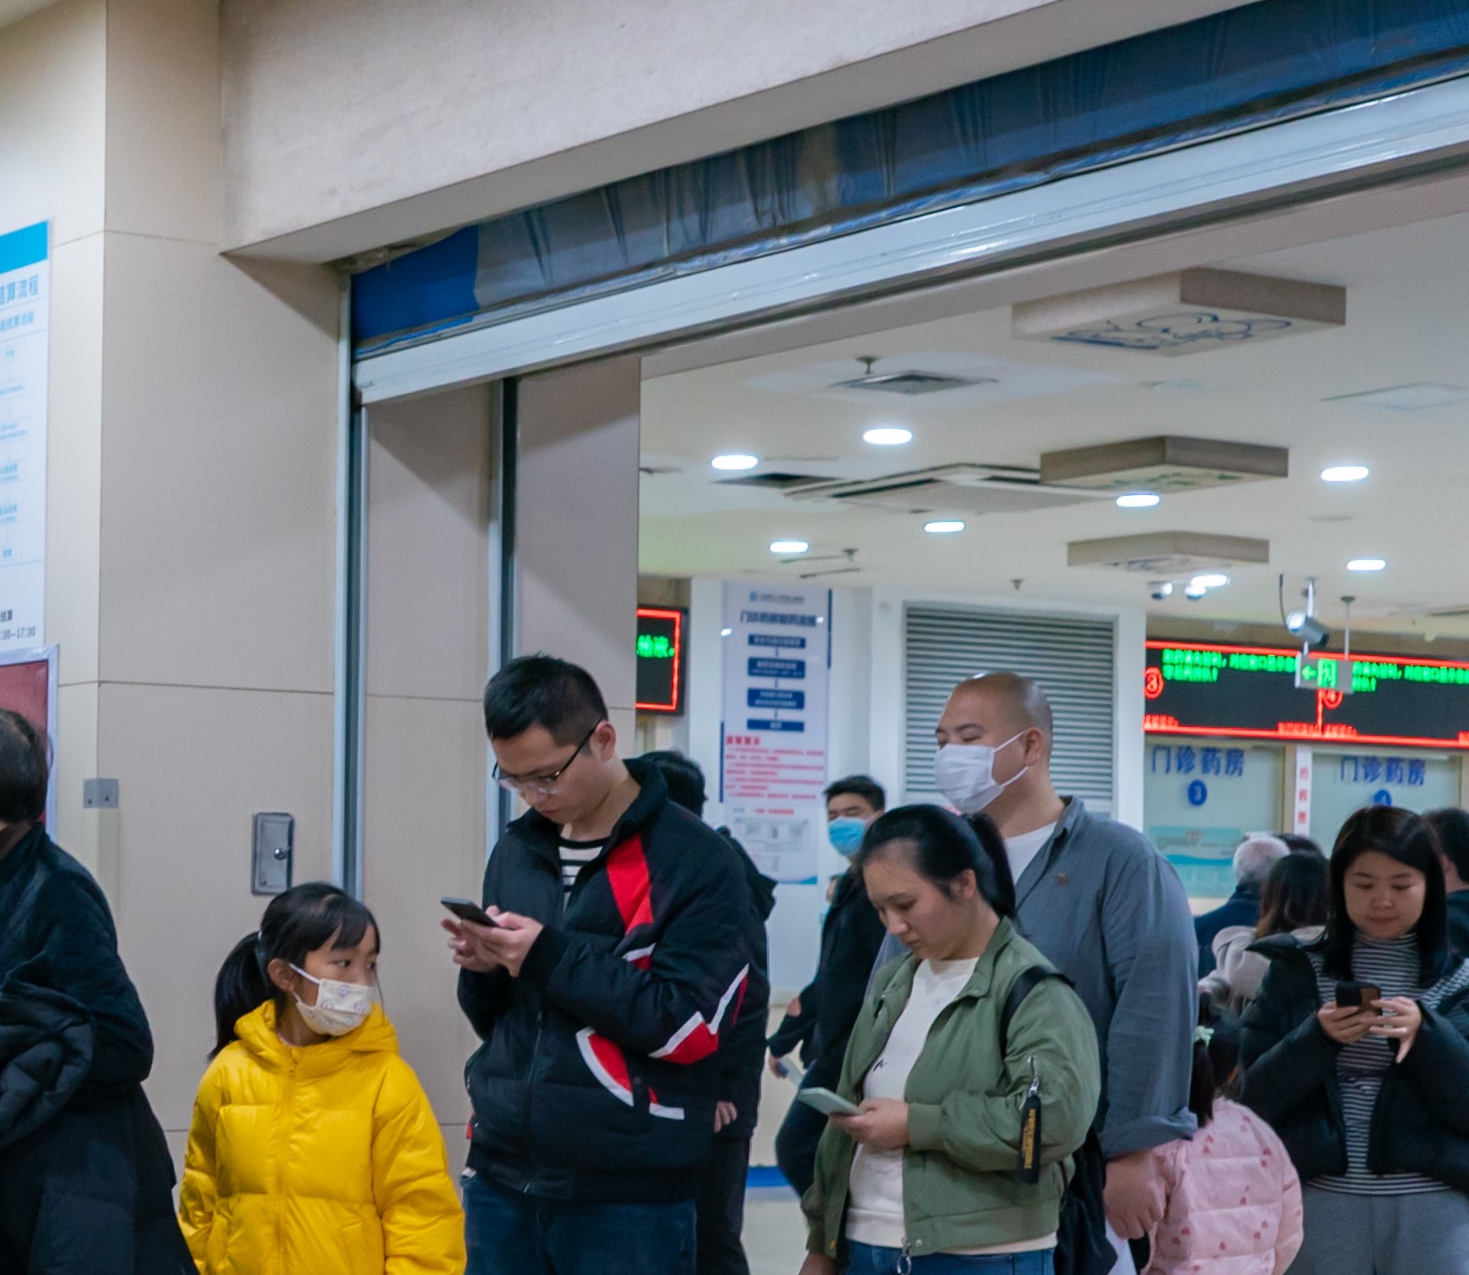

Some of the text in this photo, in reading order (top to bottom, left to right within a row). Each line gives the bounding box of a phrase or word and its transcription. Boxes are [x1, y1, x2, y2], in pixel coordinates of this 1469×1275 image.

[1151, 745, 1245, 776] 门诊药房
[1340, 756, 1426, 786] 门诊药房
